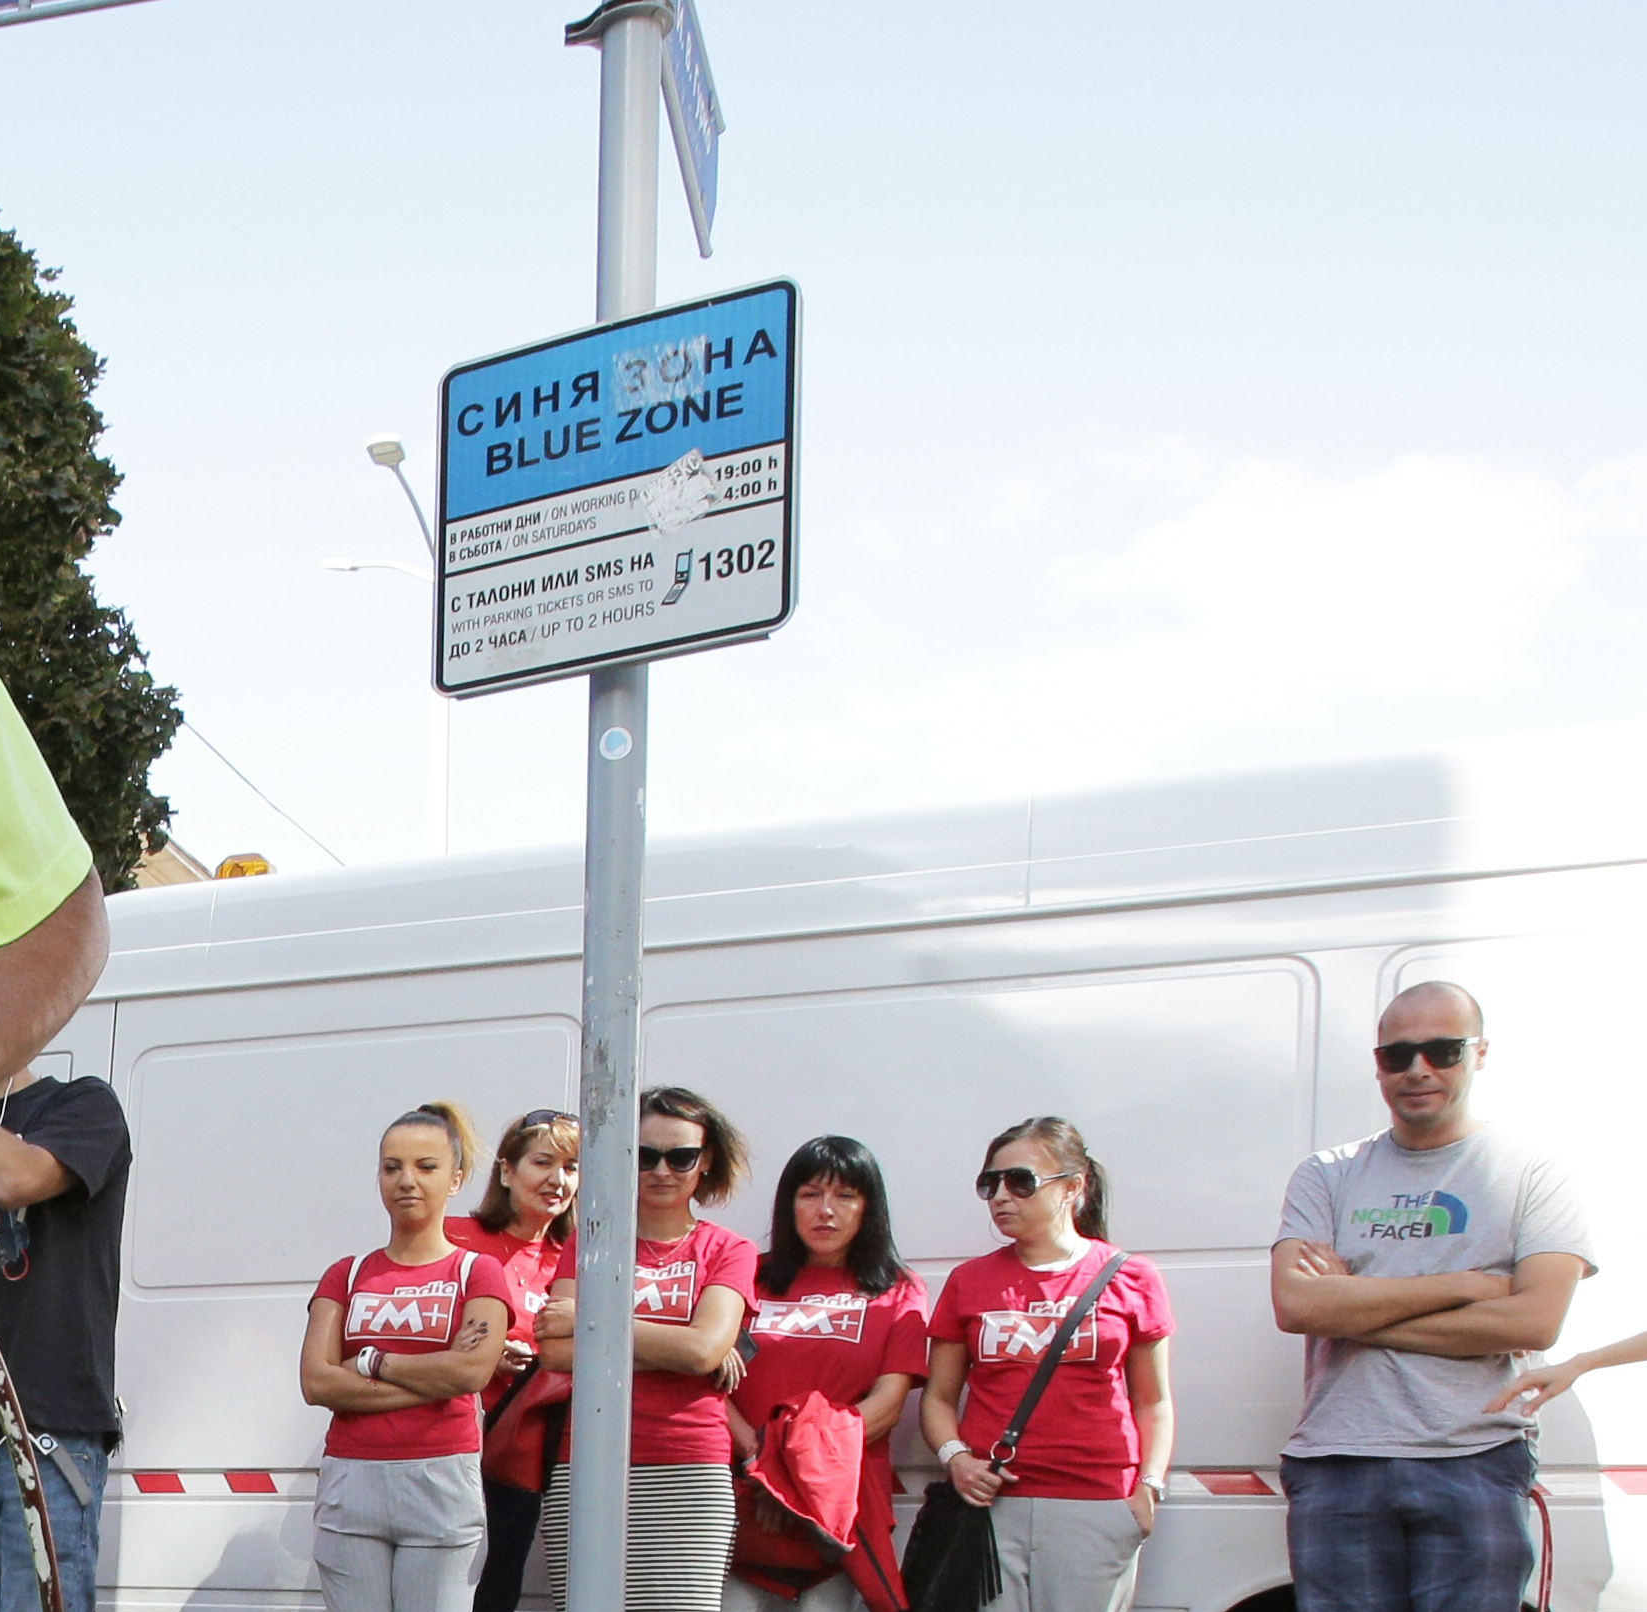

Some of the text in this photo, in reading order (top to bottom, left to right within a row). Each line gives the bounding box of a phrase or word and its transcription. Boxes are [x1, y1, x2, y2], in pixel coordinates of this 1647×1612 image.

[457, 328, 779, 437] СИНЯ ЗОНА
[486, 417, 602, 477] BLUE
[615, 382, 745, 445] ZONE
[449, 550, 456, 564] В
[459, 540, 503, 561] СЪБОТА
[512, 533, 529, 548] ON
[531, 516, 597, 543] SATURDAYS
[723, 480, 762, 502] 4:00
[768, 477, 778, 492] h
[450, 532, 457, 545] В
[460, 518, 512, 543] РАБОТНИ
[515, 511, 541, 532] ДНИ
[551, 504, 568, 520] ON
[571, 491, 626, 515] WORKING
[714, 458, 762, 482] 19:00
[768, 455, 778, 471] h
[451, 538, 777, 613] С ТАЛОНИ ИЛИ SMS НА 1302
[483, 605, 533, 627] PARKING
[537, 594, 584, 615] TICKETS
[587, 590, 604, 604] OR
[607, 583, 634, 600] SMS
[638, 578, 654, 592] TO
[448, 641, 471, 661] ДО
[475, 638, 484, 654] 2
[488, 629, 527, 649] ЧАСА
[541, 621, 561, 639] UP
[565, 616, 584, 633] TO
[588, 613, 597, 629] 2
[602, 601, 655, 625] HOURS
[1391, 1189, 1432, 1209] THE
[1370, 1221, 1424, 1241] FACE
[396, 1281, 455, 1295] radio
[633, 1282, 689, 1312] M+
[348, 1296, 448, 1334] FM+
[755, 1304, 859, 1334] FM+
